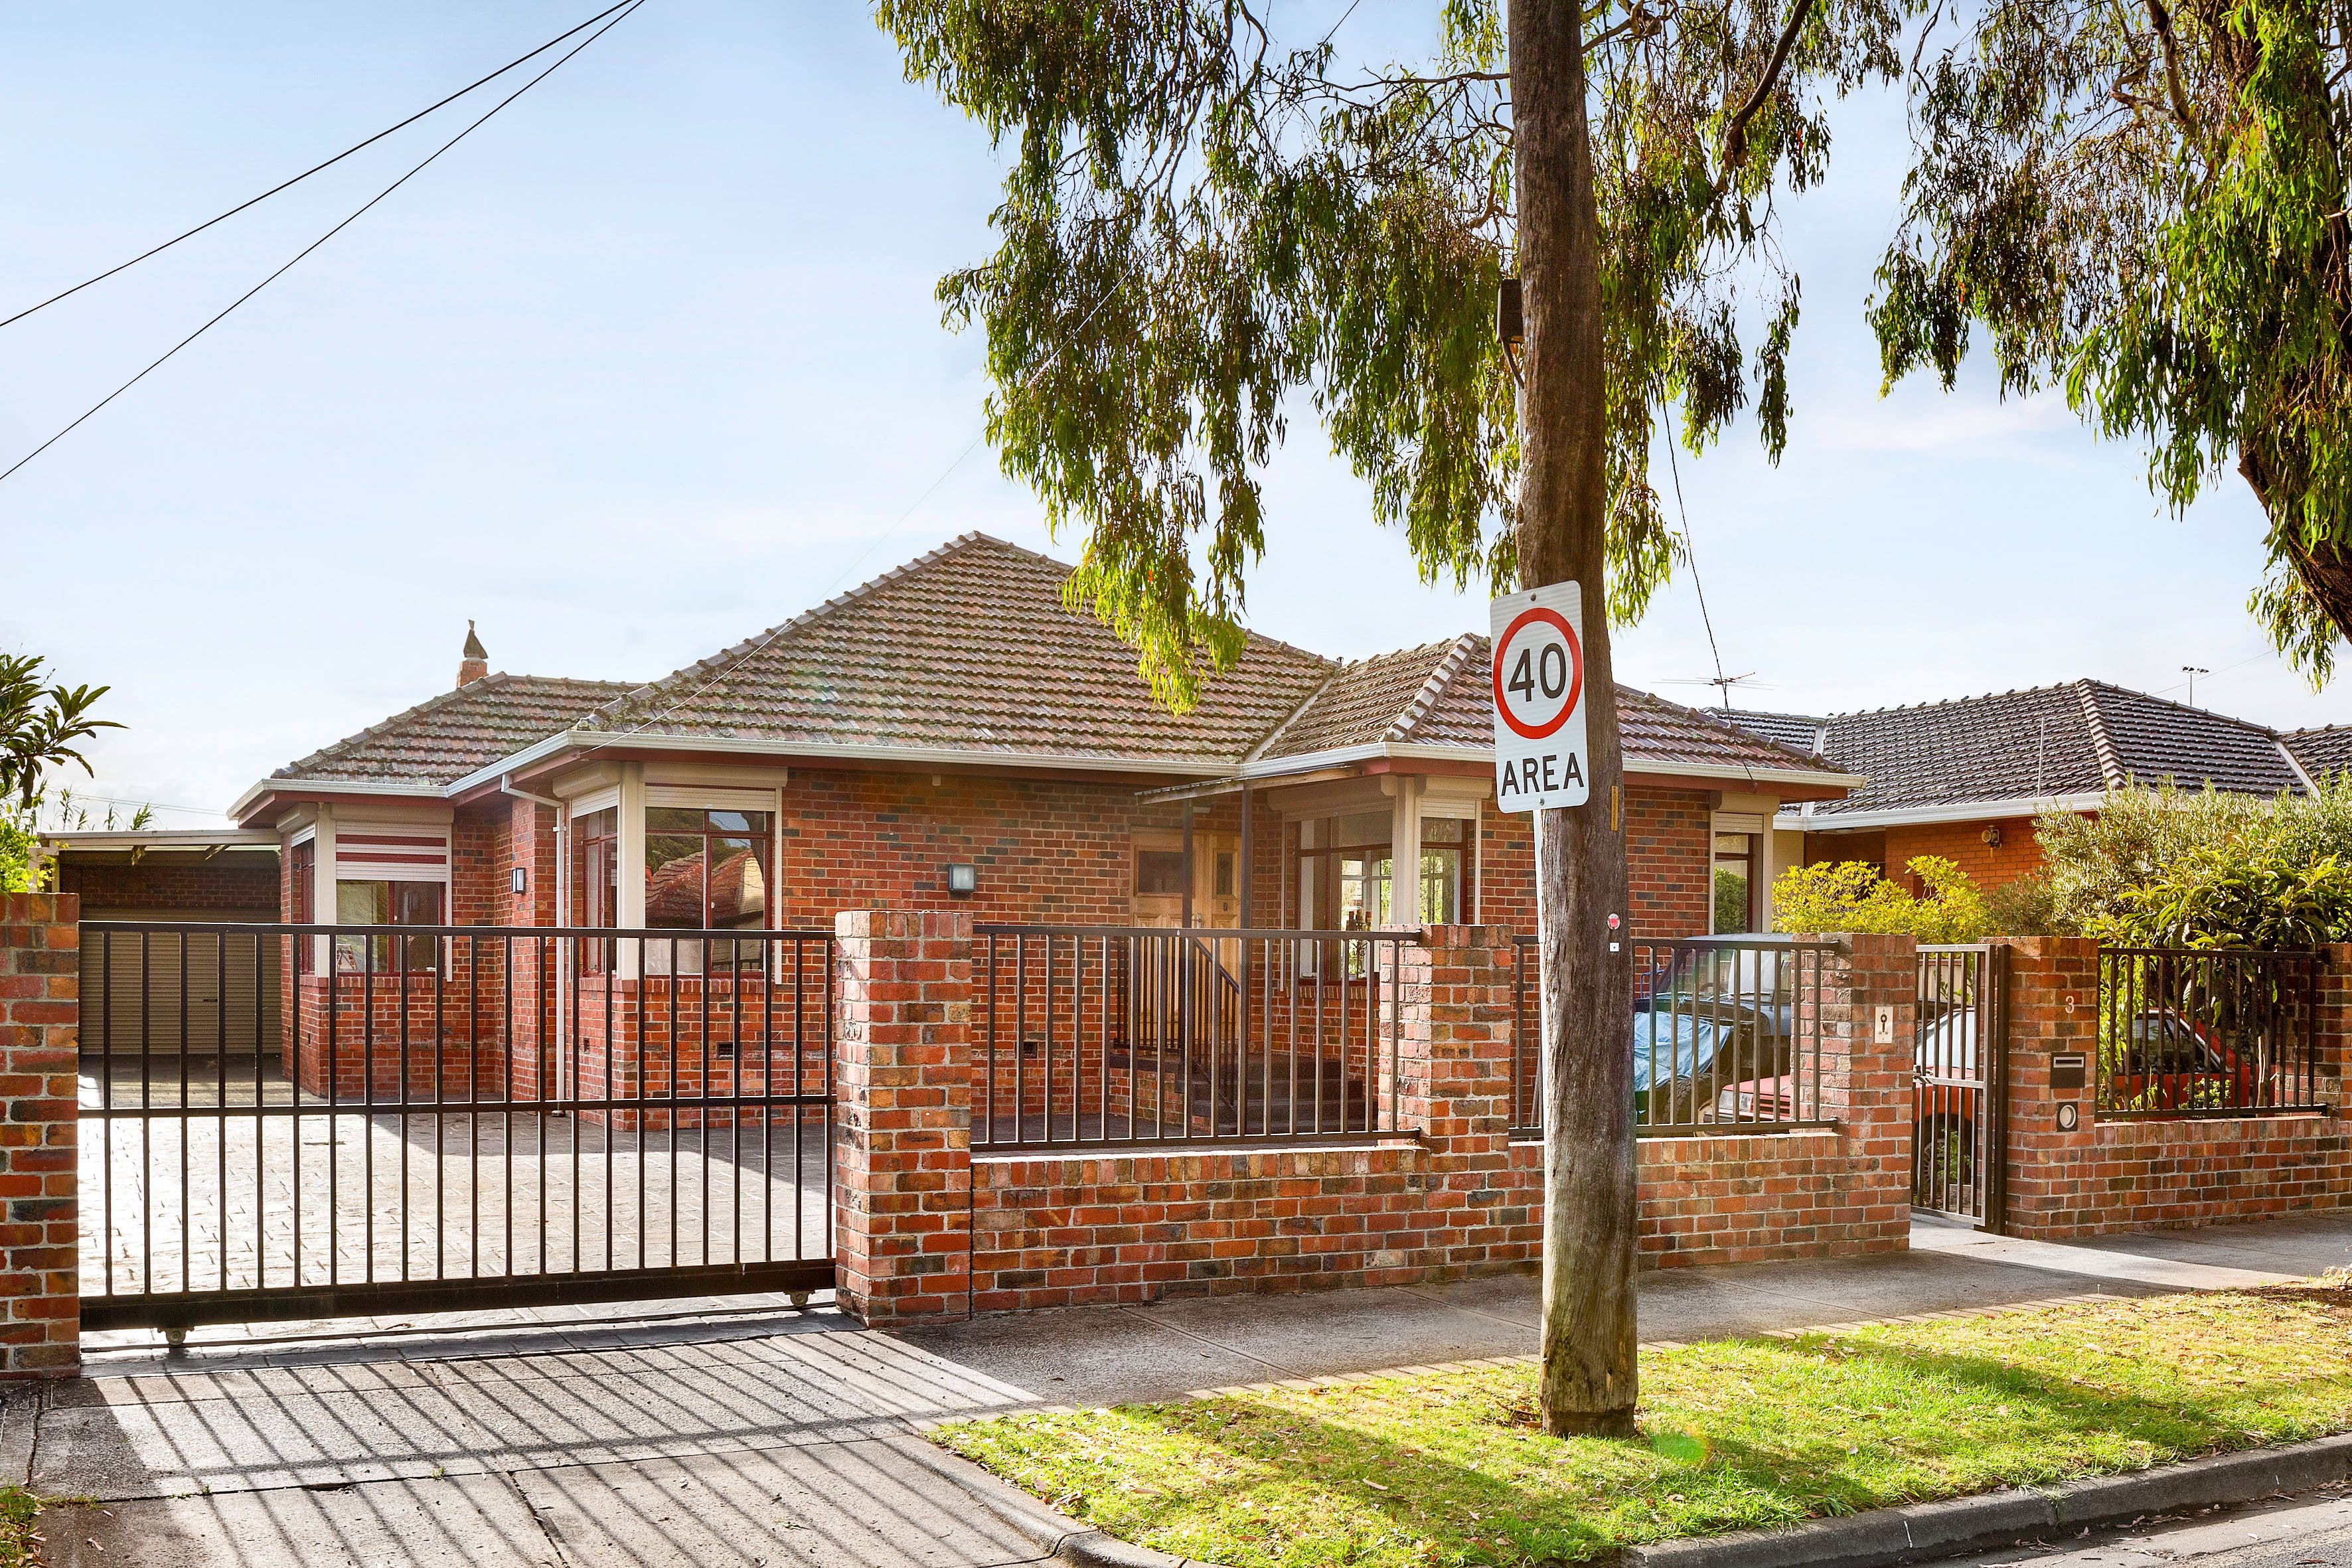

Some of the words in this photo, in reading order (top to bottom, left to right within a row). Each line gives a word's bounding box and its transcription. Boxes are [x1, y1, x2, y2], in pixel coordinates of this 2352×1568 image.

[1508, 643, 1566, 702] 40
[1501, 752, 1584, 796] AREA
[2065, 996, 2075, 1014] 3
